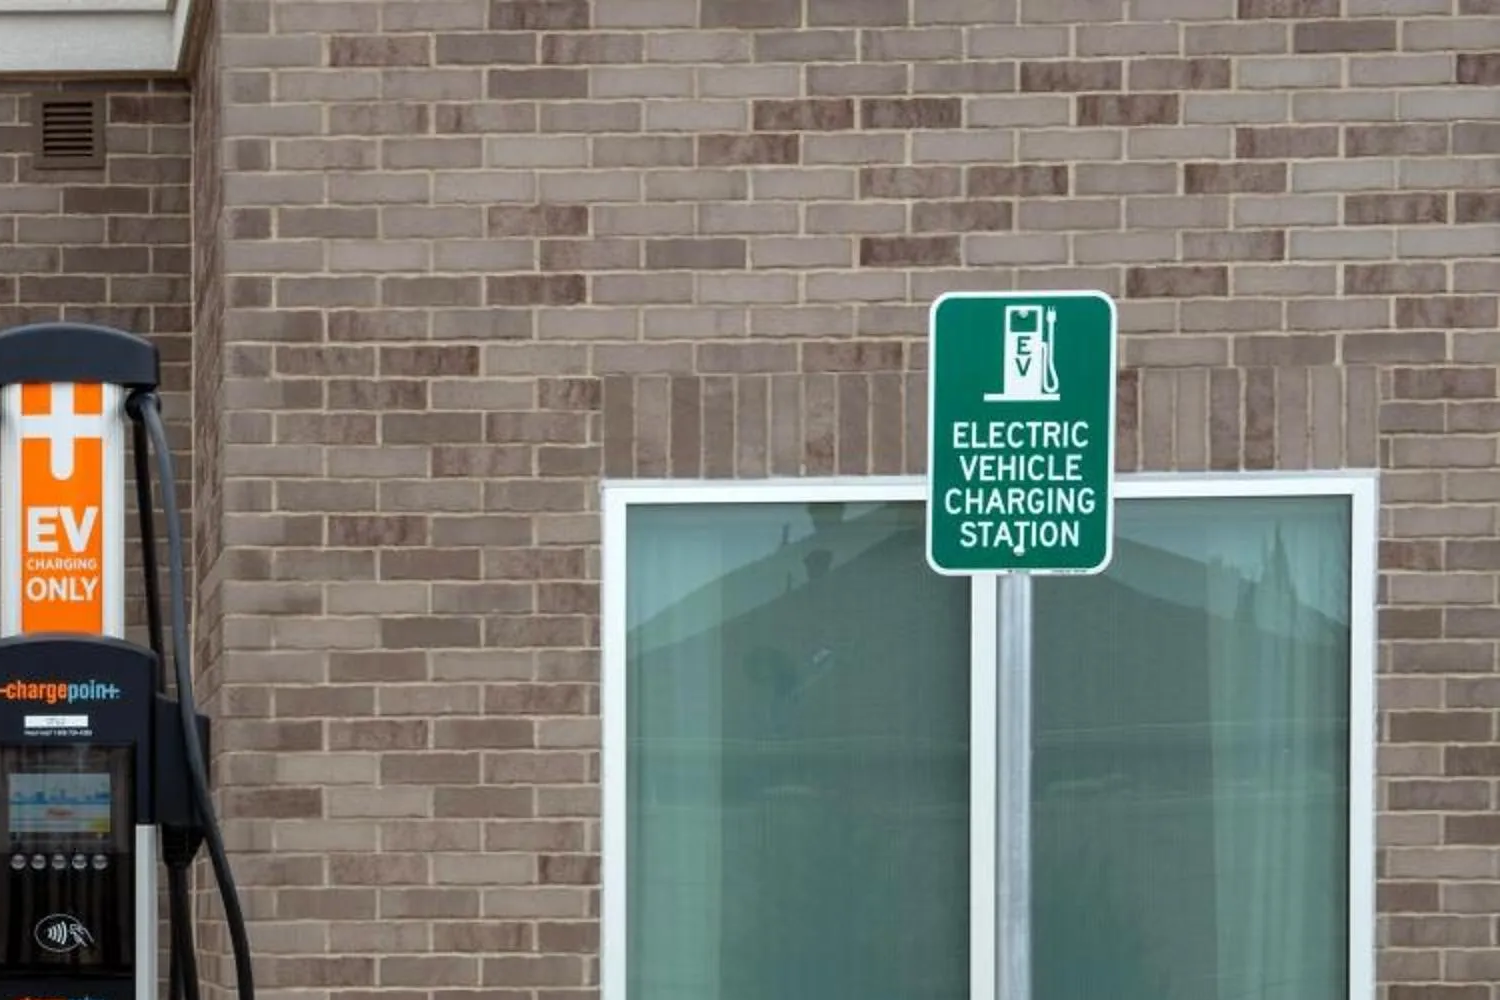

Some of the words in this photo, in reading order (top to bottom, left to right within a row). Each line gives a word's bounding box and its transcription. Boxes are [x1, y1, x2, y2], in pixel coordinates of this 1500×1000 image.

[953, 421, 1089, 449] ELECTRIC
[959, 454, 1083, 482] VEHICLE
[945, 487, 1096, 515] CHARGING
[27, 506, 99, 553] EV
[959, 520, 1080, 548] STATION
[26, 558, 98, 571] CHARGING
[26, 576, 99, 602] ONLY
